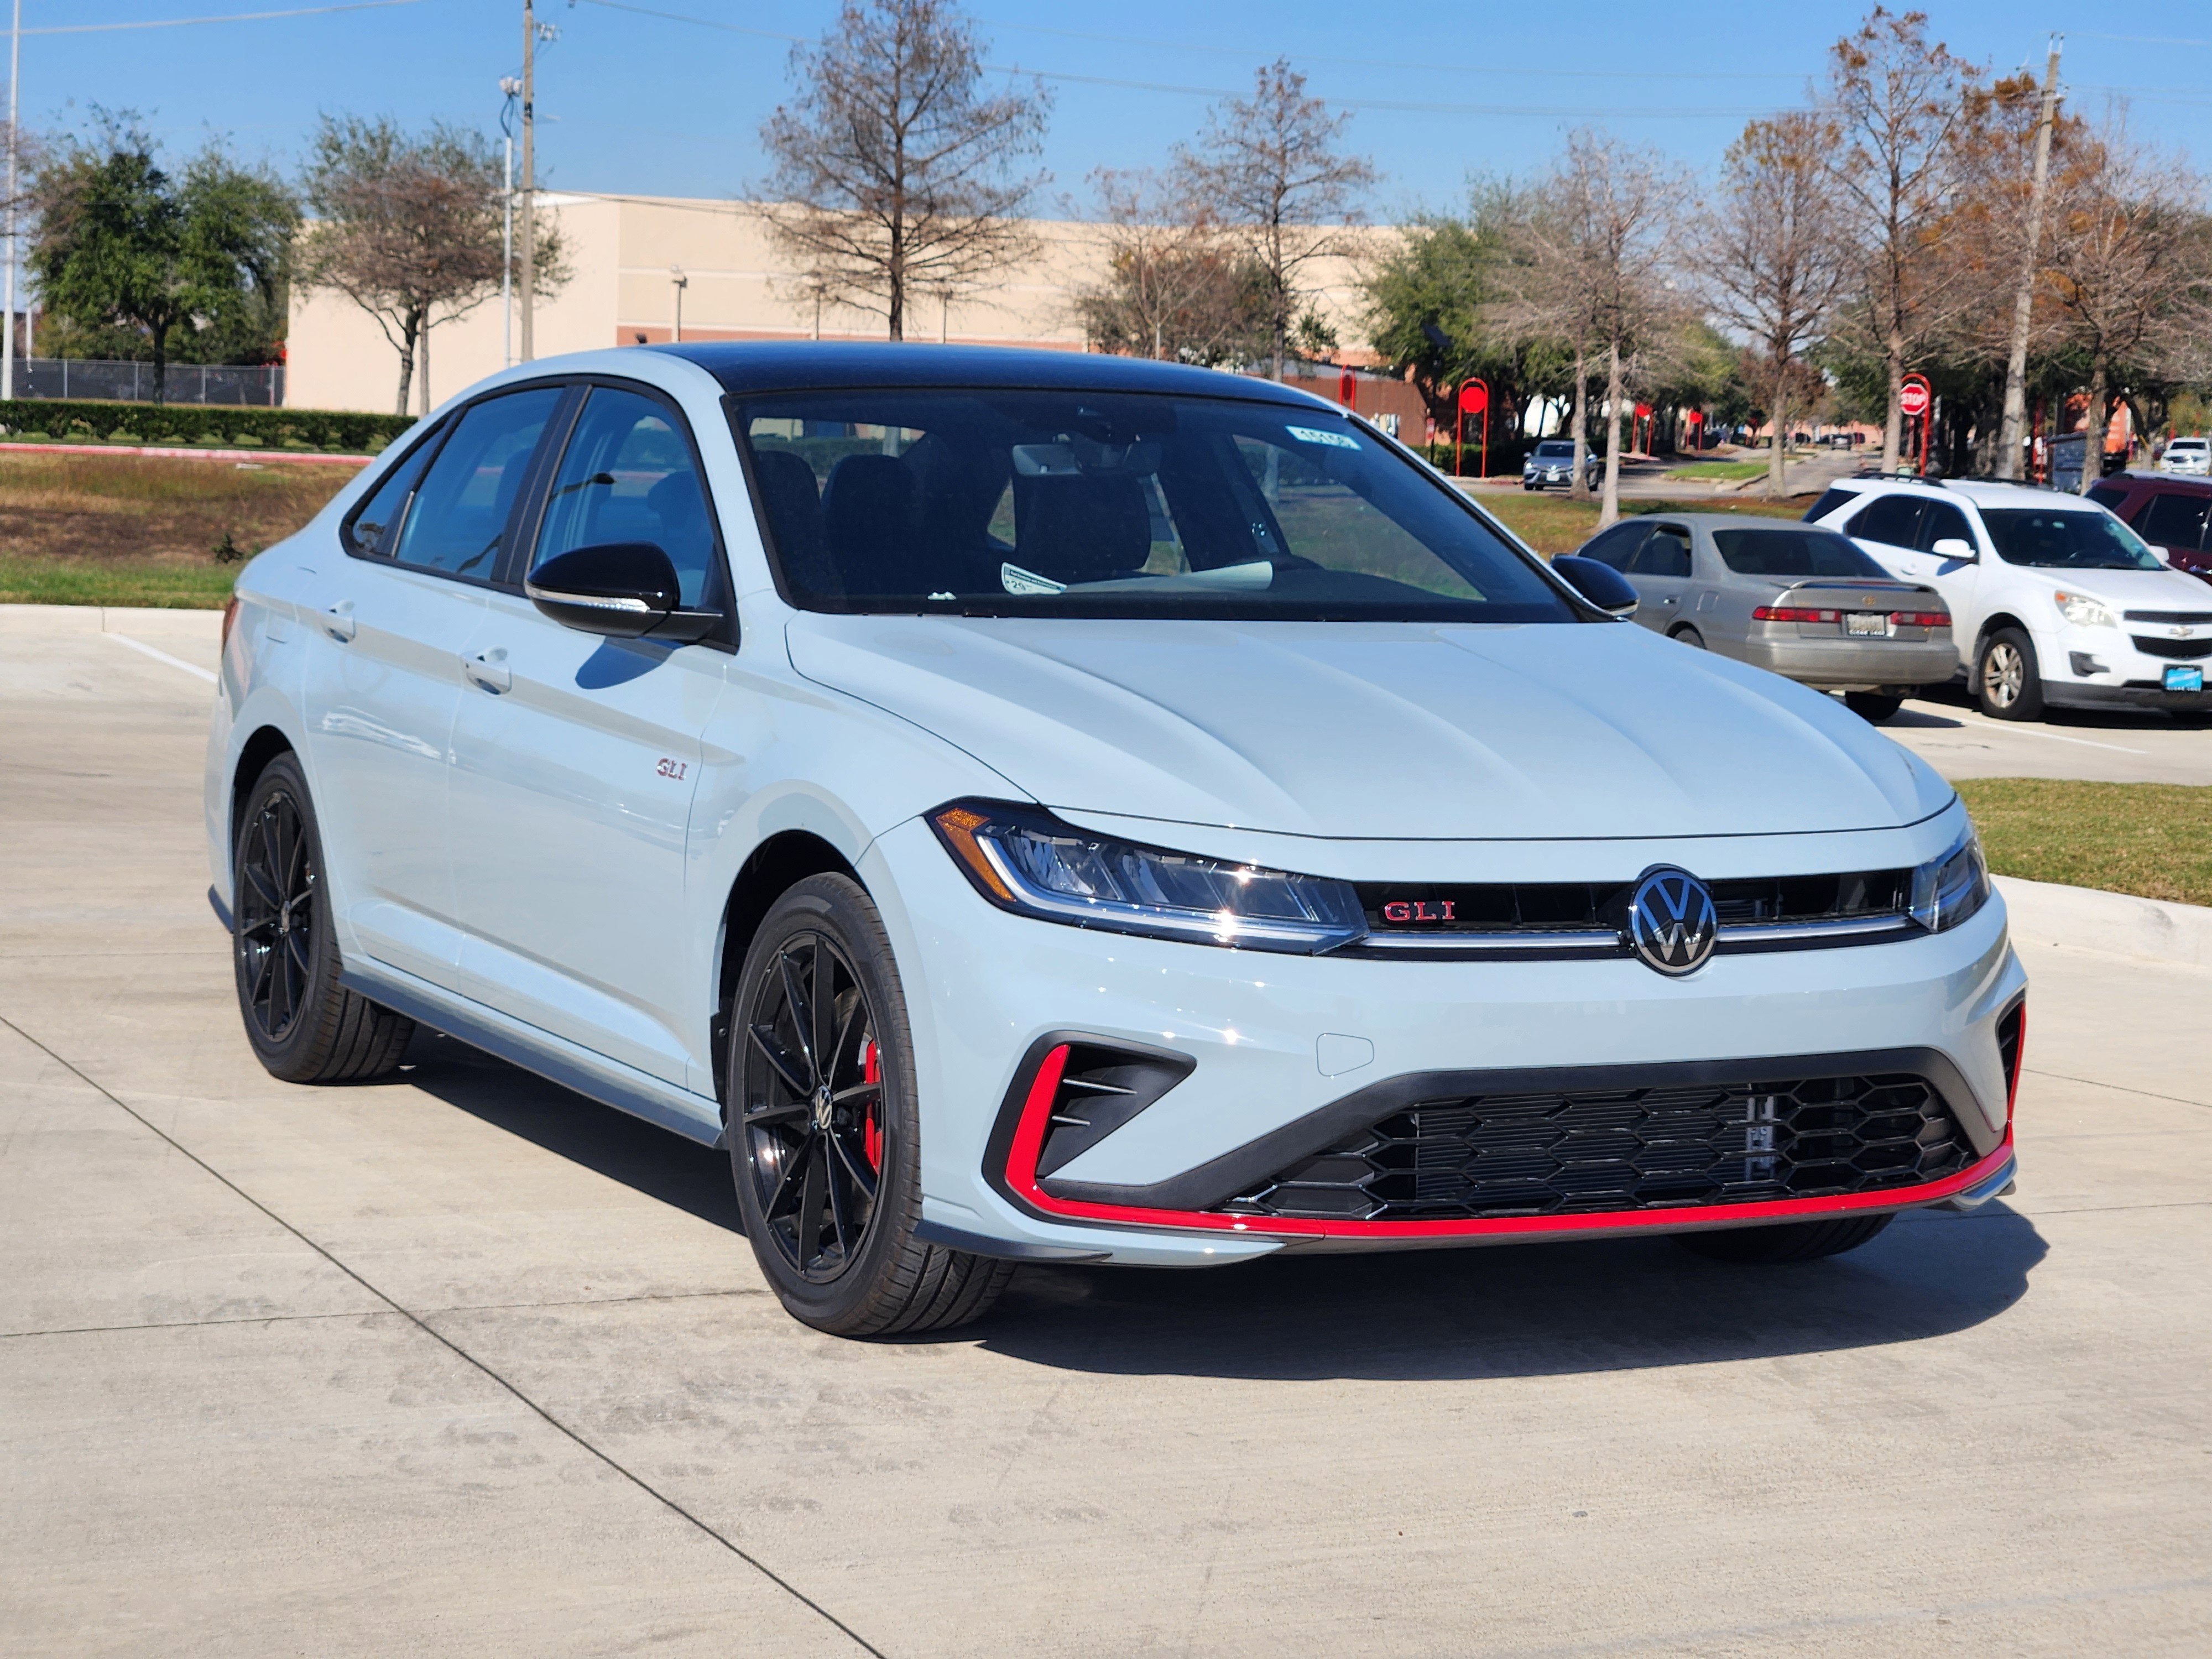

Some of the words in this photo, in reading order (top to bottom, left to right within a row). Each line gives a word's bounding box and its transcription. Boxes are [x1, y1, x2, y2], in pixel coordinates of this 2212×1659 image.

[1901, 392, 1926, 405] STOP
[656, 758, 688, 780] GLI
[1384, 900, 1455, 921] GLI
[1637, 873, 1713, 962] VW
